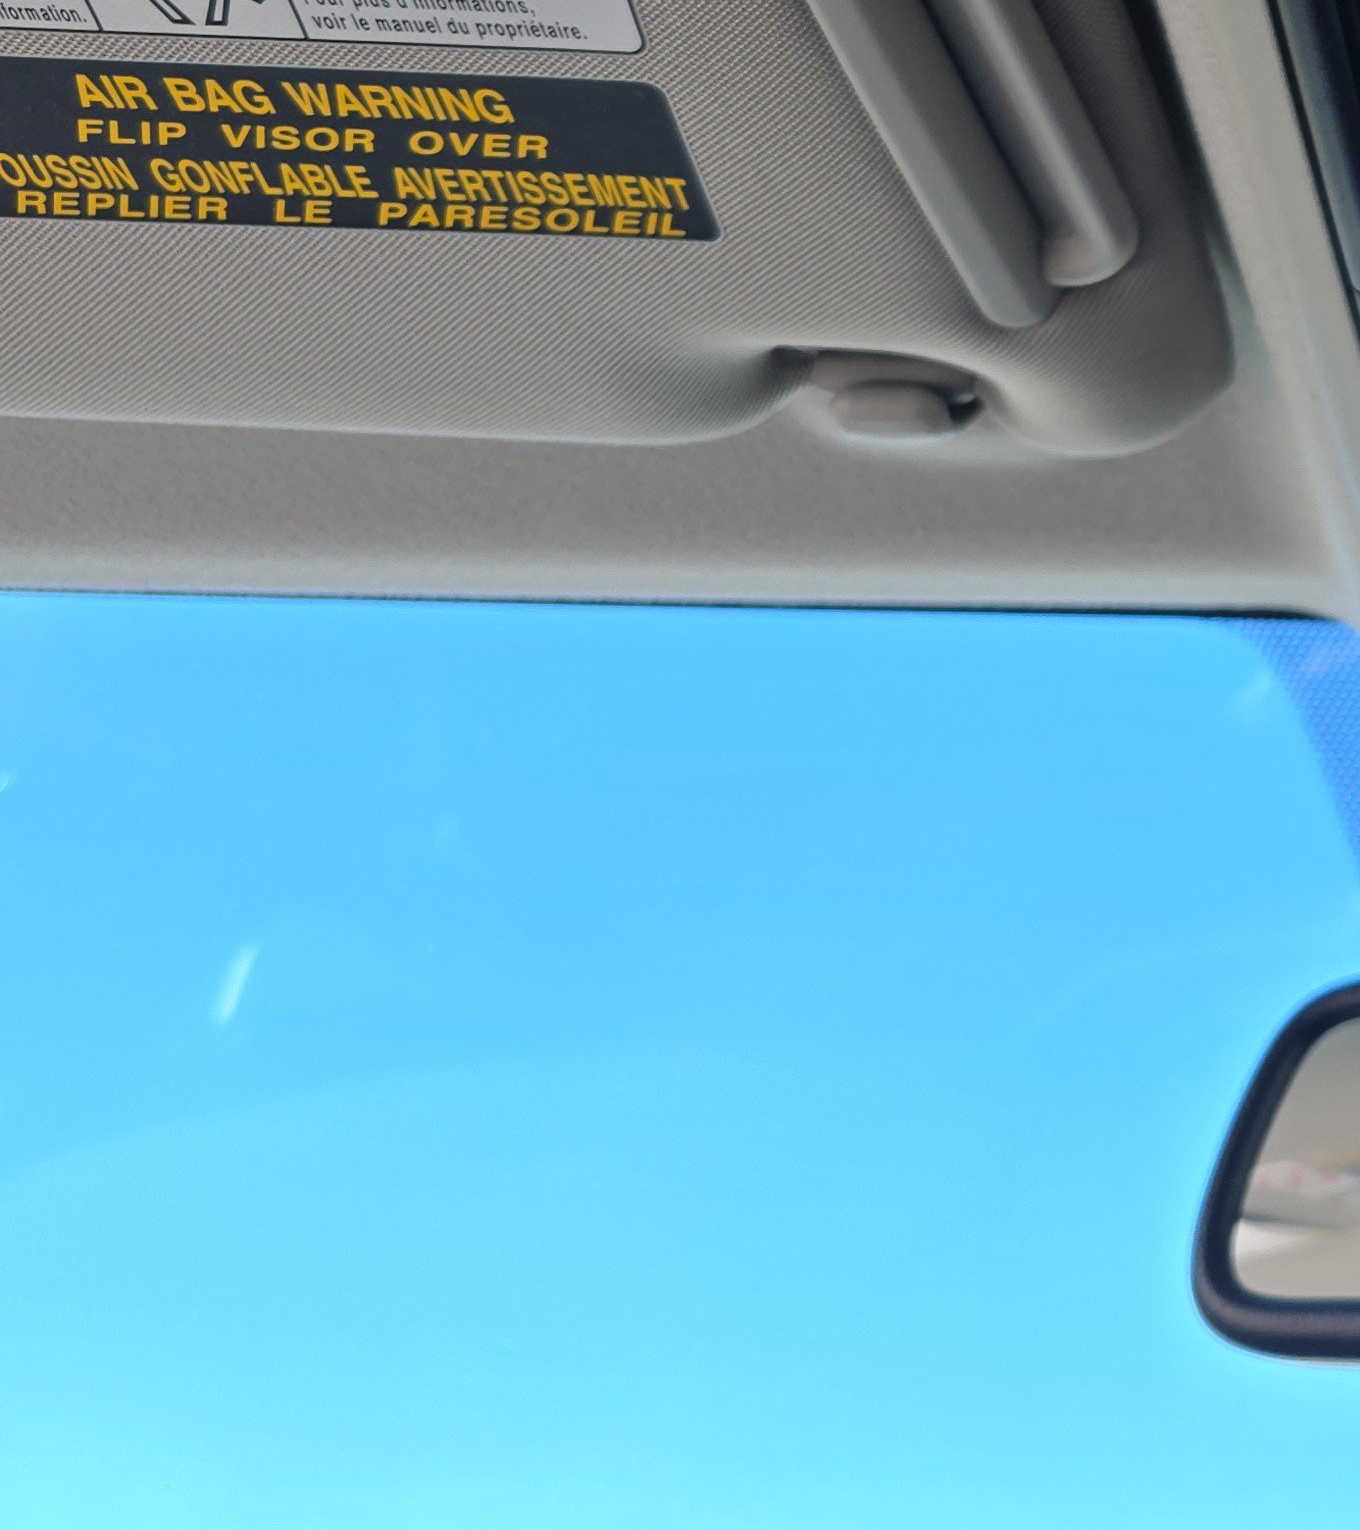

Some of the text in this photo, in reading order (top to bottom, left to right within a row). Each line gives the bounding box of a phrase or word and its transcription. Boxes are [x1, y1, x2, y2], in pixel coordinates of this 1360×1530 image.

[311, 13, 587, 40] voir le manuel du propriétaire.
[76, 74, 514, 123] AIR BAG WARNING
[78, 119, 548, 158] FLIP VISOR OVER
[0, 153, 689, 211] OUSSIN GONFLABLE AVERTISSEMENT
[18, 190, 688, 237] REPLIER LE PARESOLEIL
